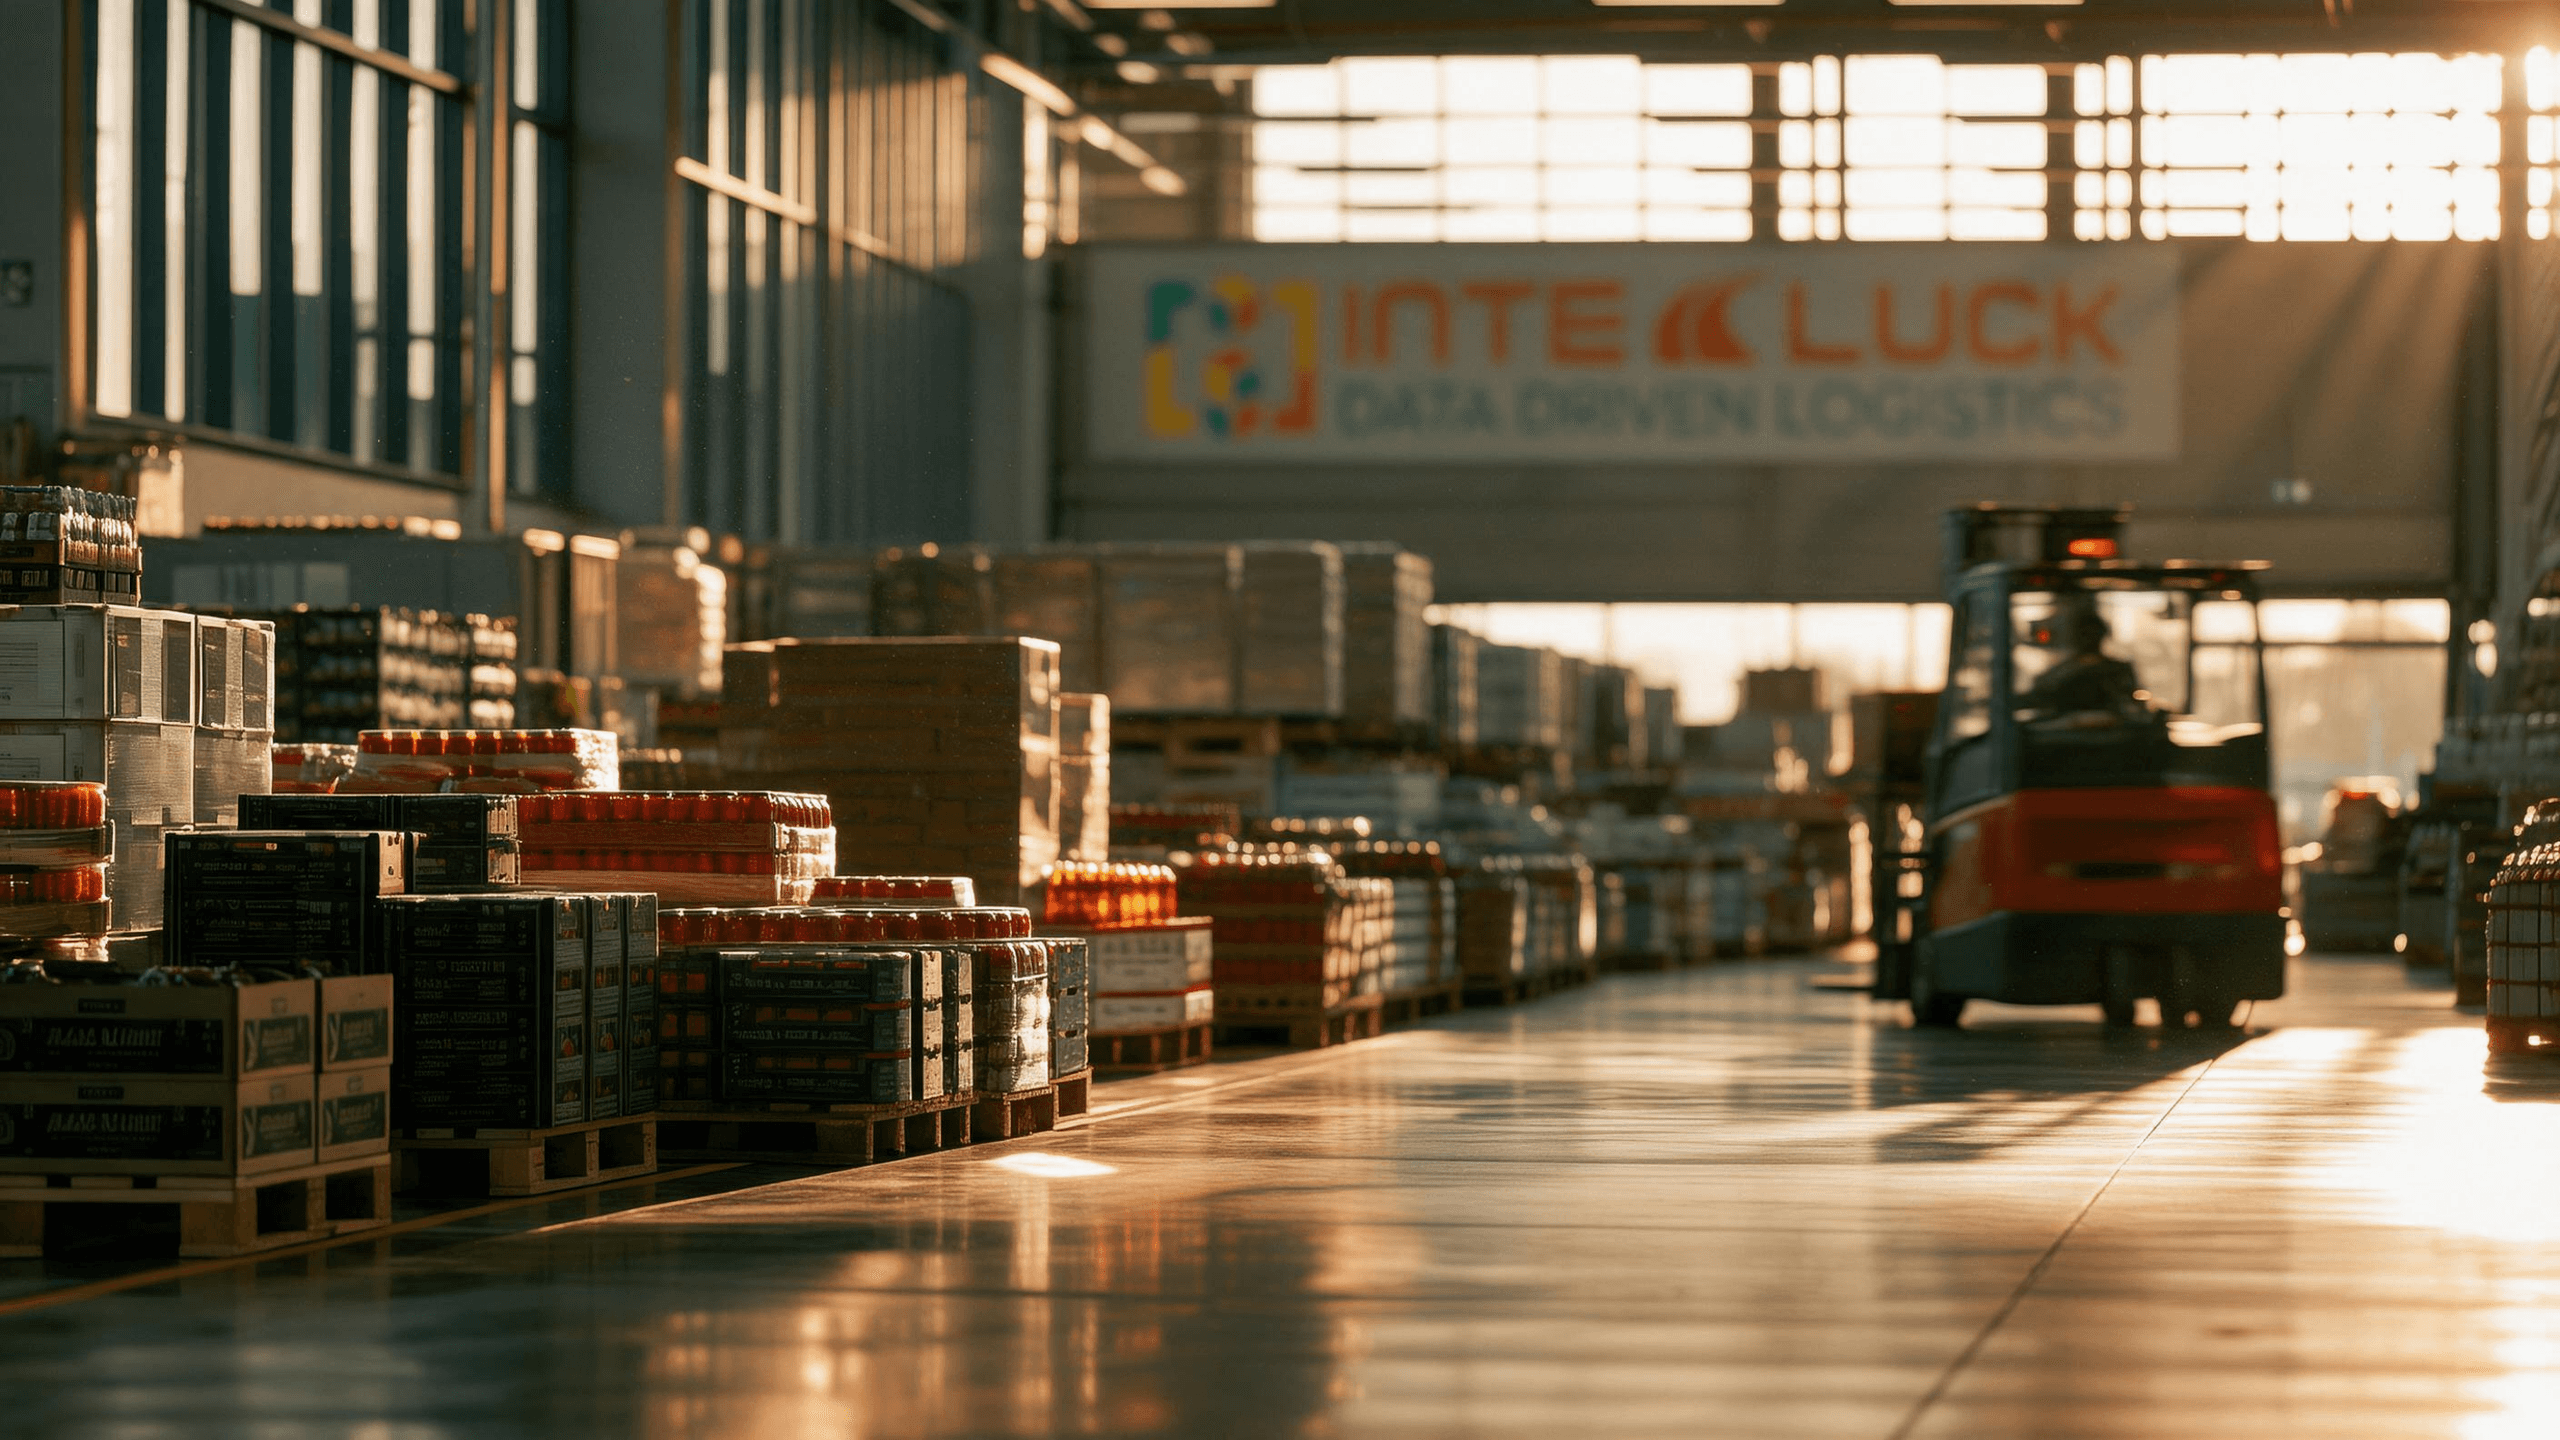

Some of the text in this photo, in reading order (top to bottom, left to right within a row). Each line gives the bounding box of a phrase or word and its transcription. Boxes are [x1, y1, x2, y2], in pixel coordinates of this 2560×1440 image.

[1336, 380, 2125, 437] DATA DRIVEN LOGISTICS
